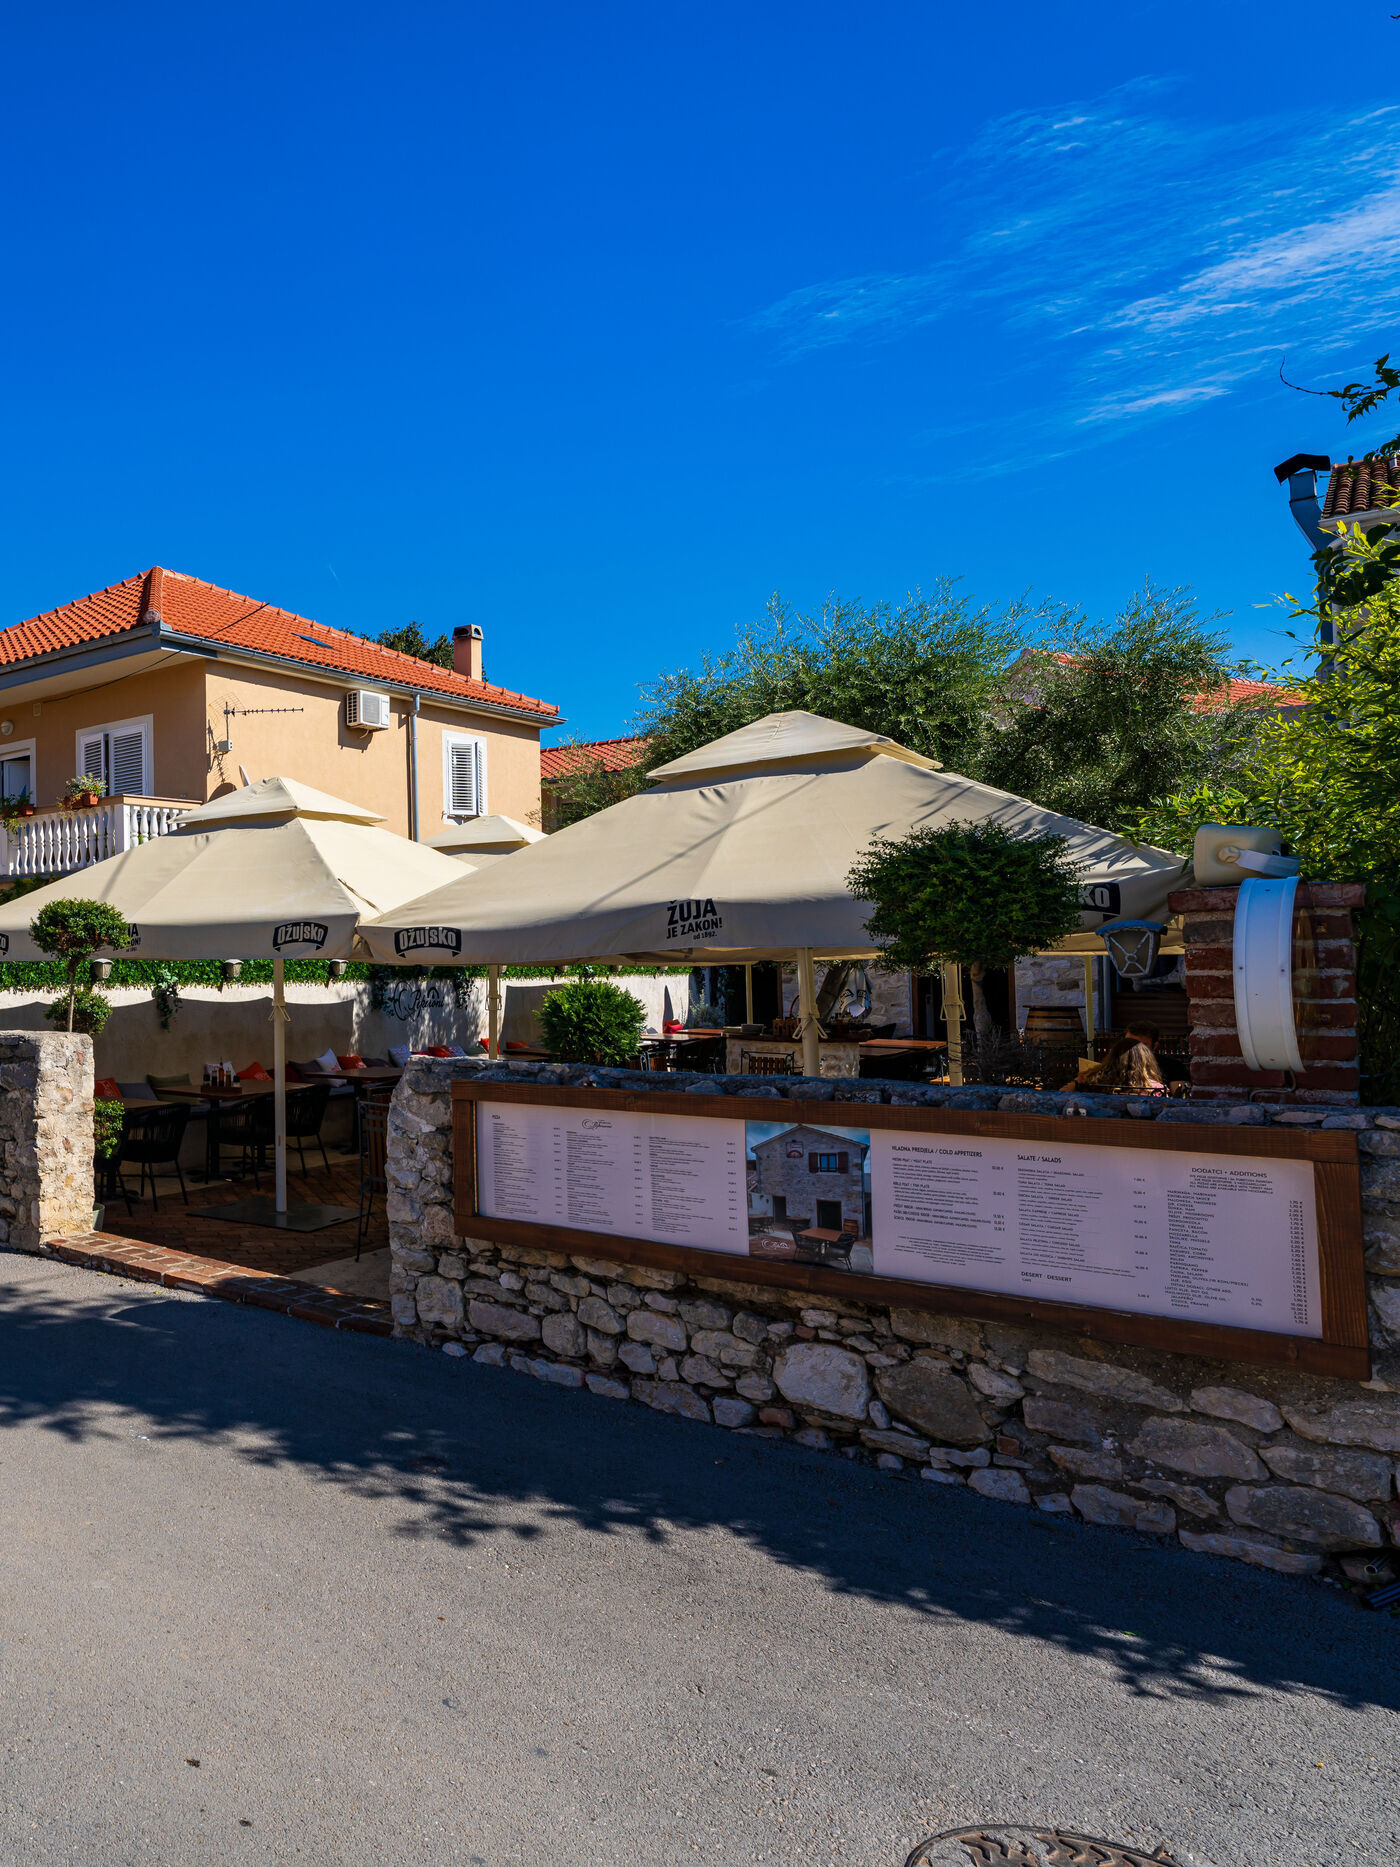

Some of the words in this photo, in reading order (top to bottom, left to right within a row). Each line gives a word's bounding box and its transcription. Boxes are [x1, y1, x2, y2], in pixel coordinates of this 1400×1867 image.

[667, 898, 717, 926] ŽUJA
[277, 923, 324, 944] Ožujsko
[399, 926, 457, 950] Ožujsko
[666, 926, 678, 939] JE
[680, 917, 723, 936] ZAKON!
[1229, 1170, 1268, 1179] ADDITIONS
